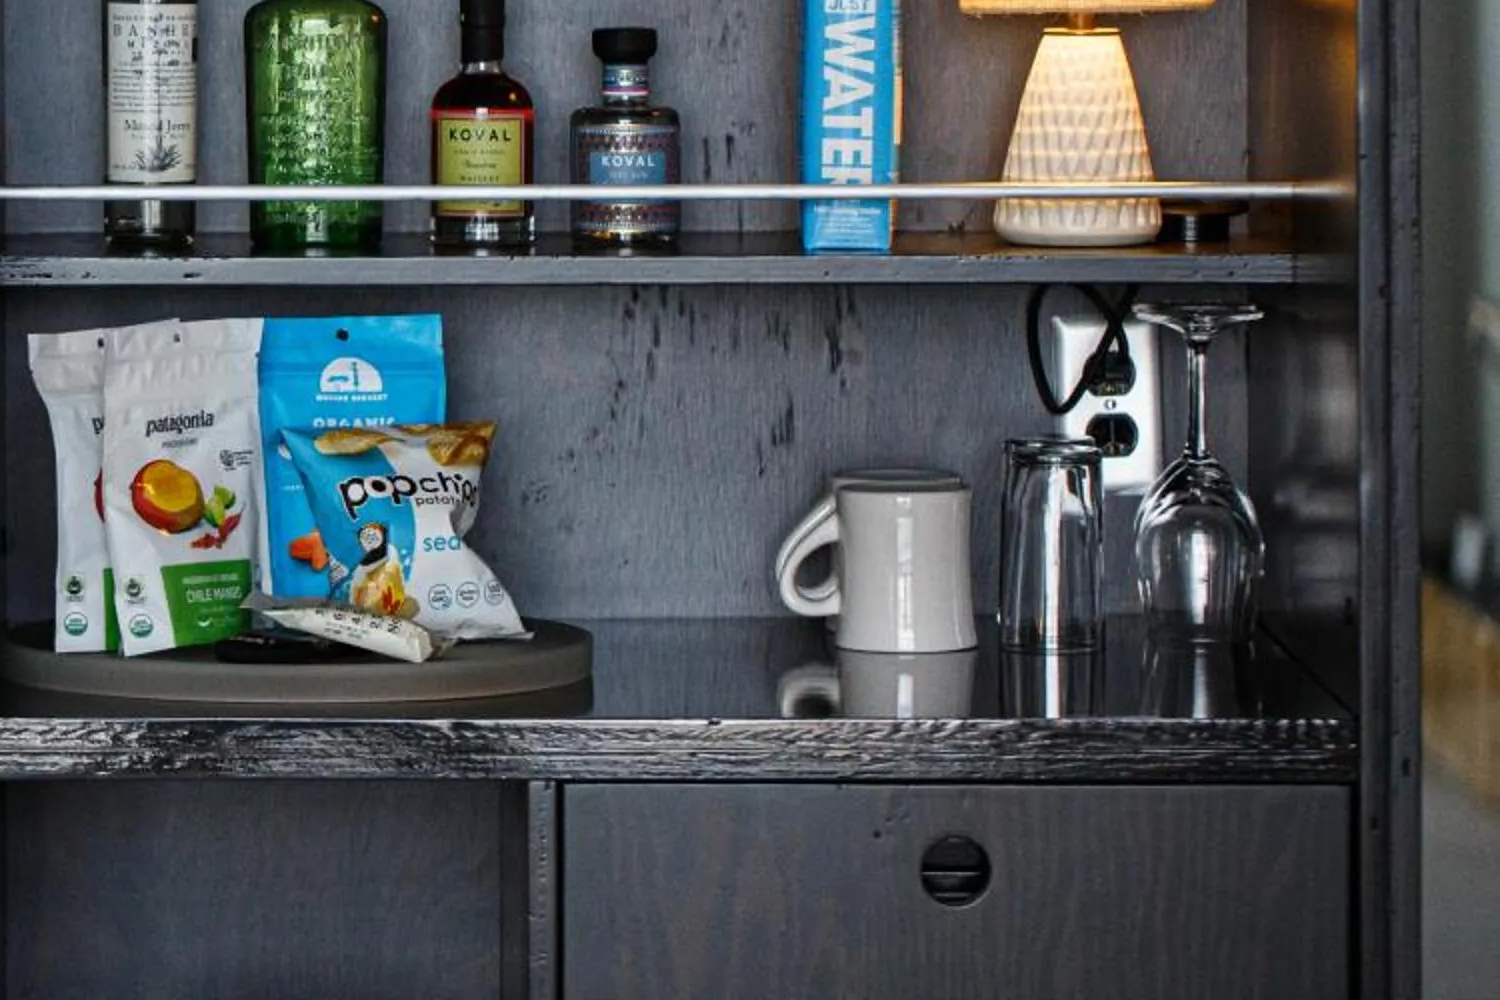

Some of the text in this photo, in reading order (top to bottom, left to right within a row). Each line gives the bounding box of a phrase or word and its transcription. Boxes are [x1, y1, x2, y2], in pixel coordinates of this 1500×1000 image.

[448, 128, 512, 141] KOVAL
[602, 155, 656, 167] KOVAL
[145, 410, 215, 437] patagonia
